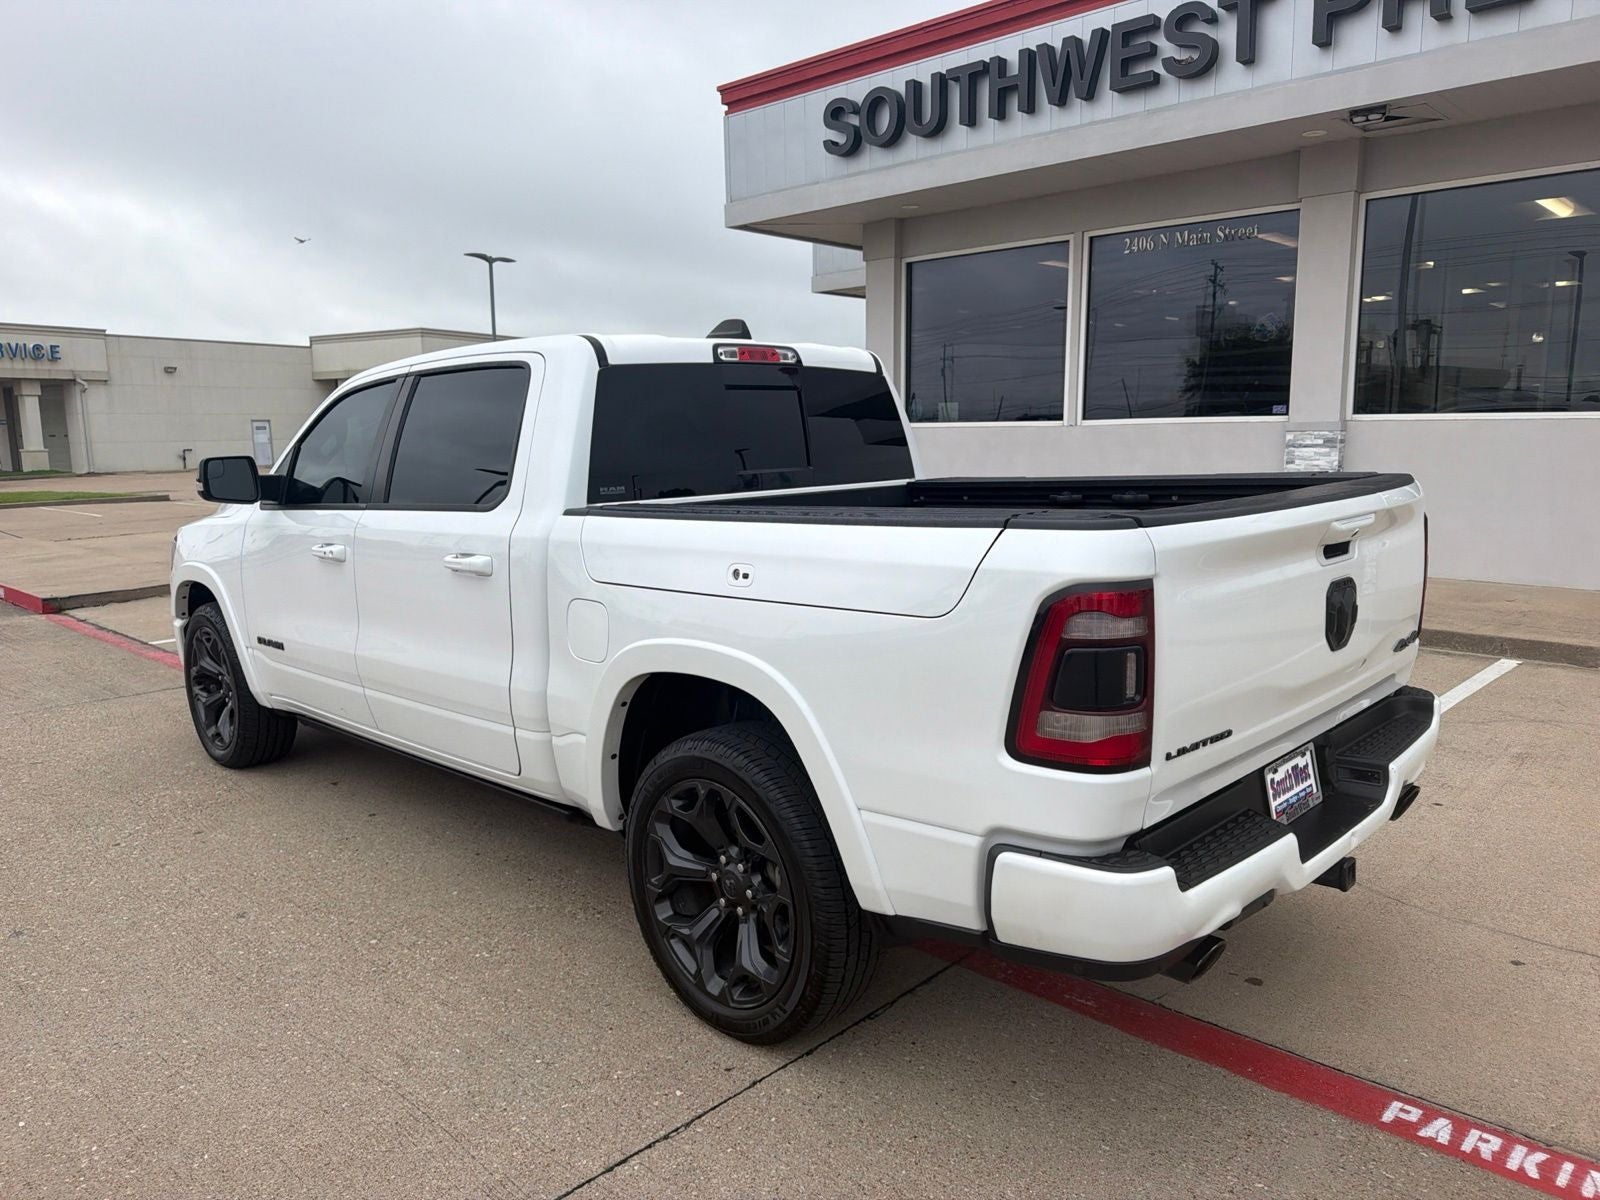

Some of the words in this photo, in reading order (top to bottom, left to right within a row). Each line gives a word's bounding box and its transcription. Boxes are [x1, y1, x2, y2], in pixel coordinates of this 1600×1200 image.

[823, 0, 1274, 157] SOUTHWEST
[1123, 237, 1154, 254] 2406
[1158, 233, 1169, 250] N
[1174, 230, 1211, 248] Main
[1216, 224, 1258, 243] Street
[1165, 728, 1233, 761] LIMITED
